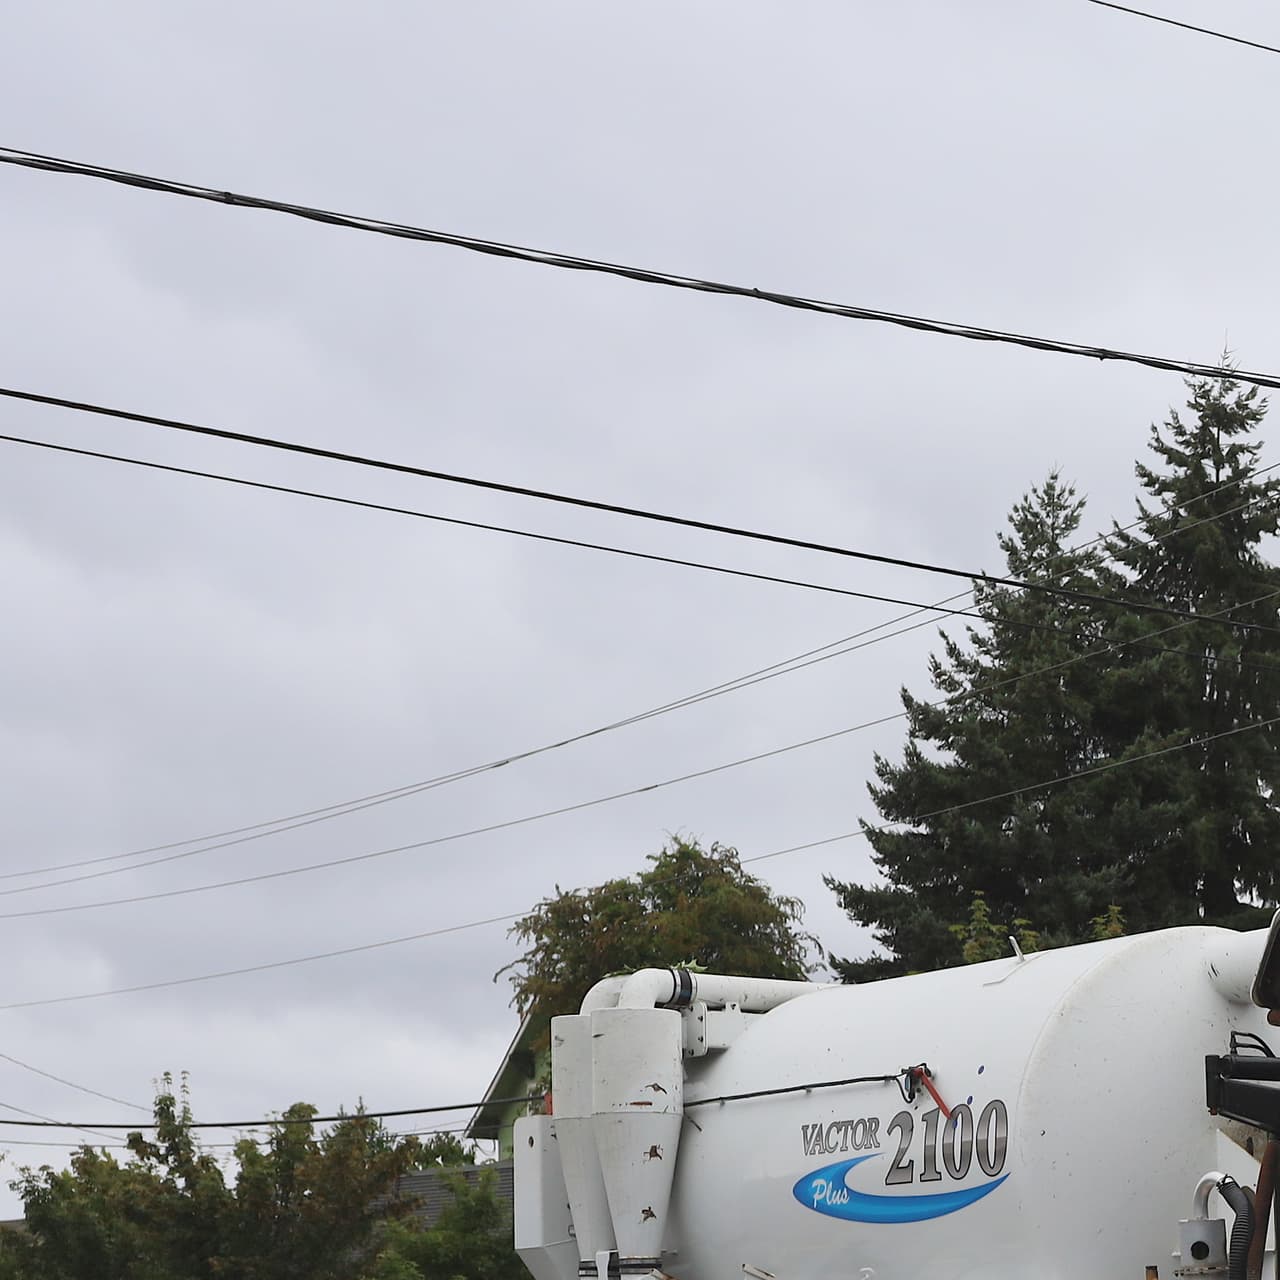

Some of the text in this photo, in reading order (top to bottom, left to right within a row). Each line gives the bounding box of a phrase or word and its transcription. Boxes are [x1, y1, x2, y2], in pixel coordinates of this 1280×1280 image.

[801, 1099, 1009, 1186] VACTOR 2100
[811, 1178, 850, 1208] Plus
